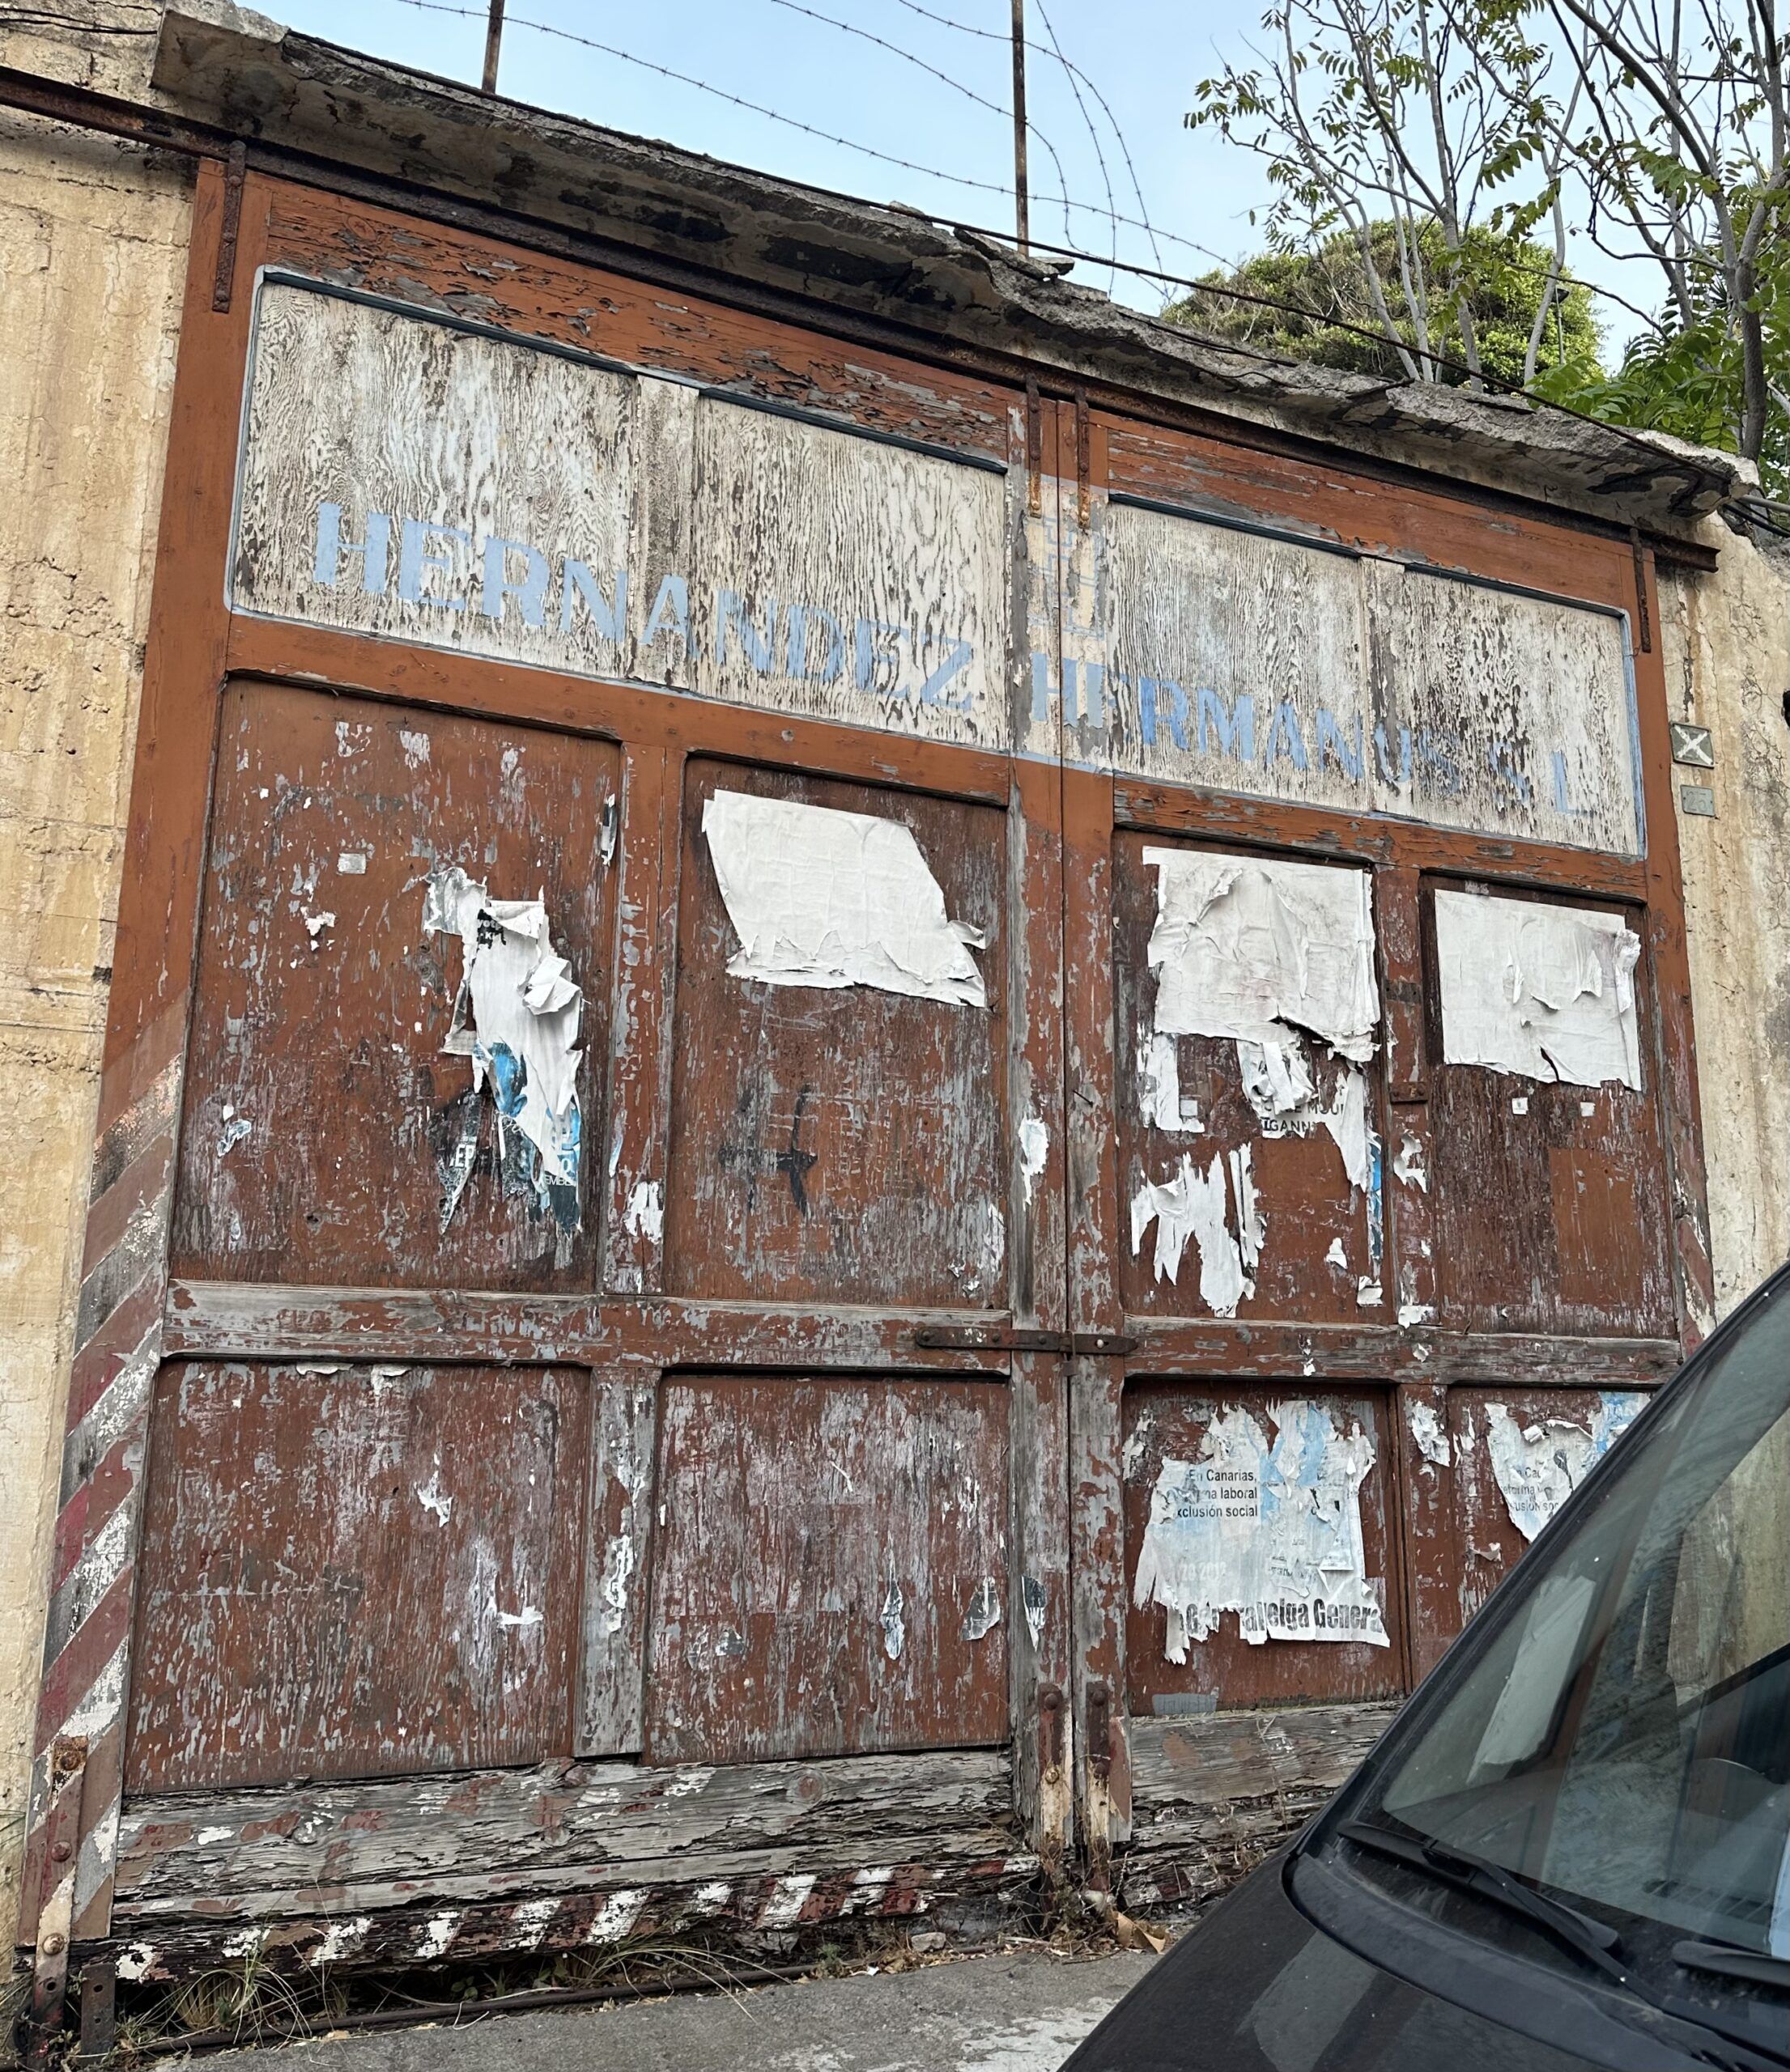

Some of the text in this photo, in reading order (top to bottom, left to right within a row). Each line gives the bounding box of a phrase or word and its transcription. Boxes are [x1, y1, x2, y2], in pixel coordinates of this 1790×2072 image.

[313, 502, 972, 711] HERNANDEZ
[1206, 1468, 1257, 1483] Canarias,
[1220, 1487, 1257, 1499] laboral
[1177, 1505, 1258, 1518] xclusión social
[1313, 1598, 1383, 1633] Genera
